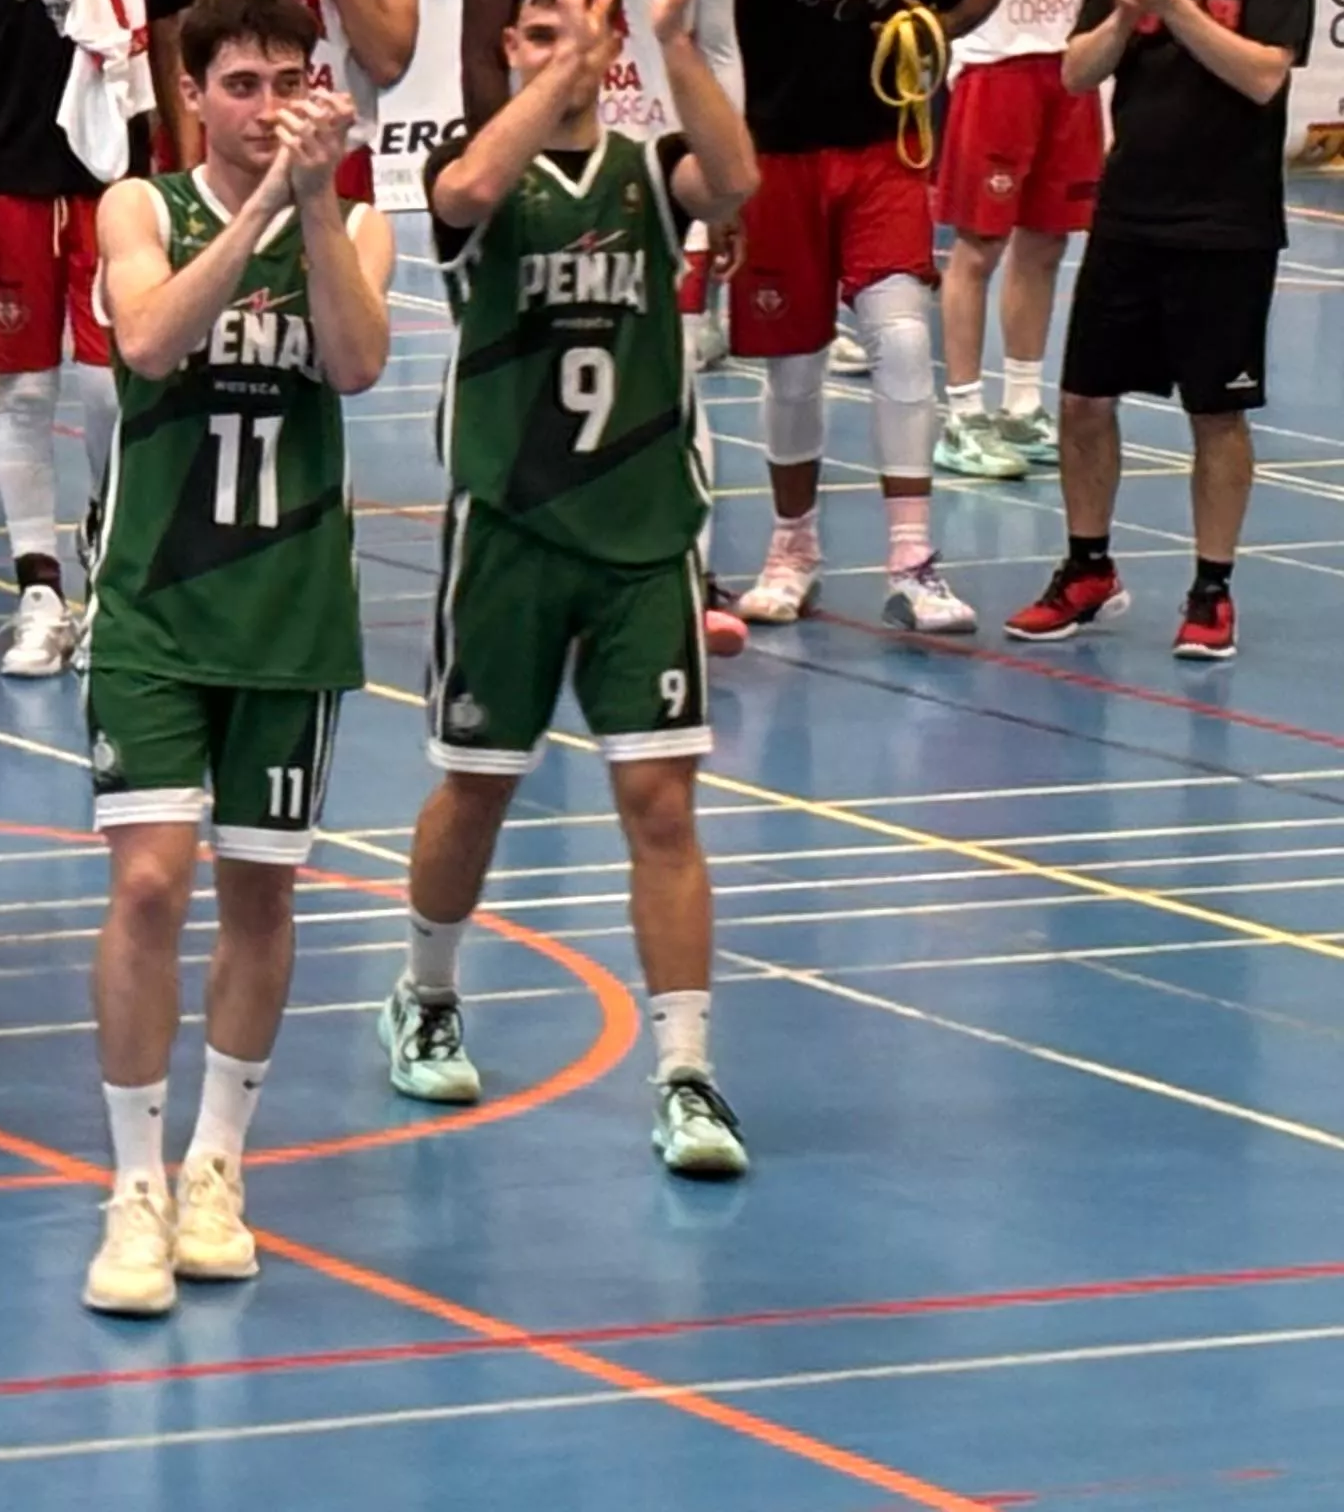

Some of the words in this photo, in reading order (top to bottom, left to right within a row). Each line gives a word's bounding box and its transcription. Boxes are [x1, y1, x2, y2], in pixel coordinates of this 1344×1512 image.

[559, 346, 615, 453] 9
[208, 412, 284, 529] 11
[659, 668, 688, 718] 9
[267, 765, 305, 819] 11
